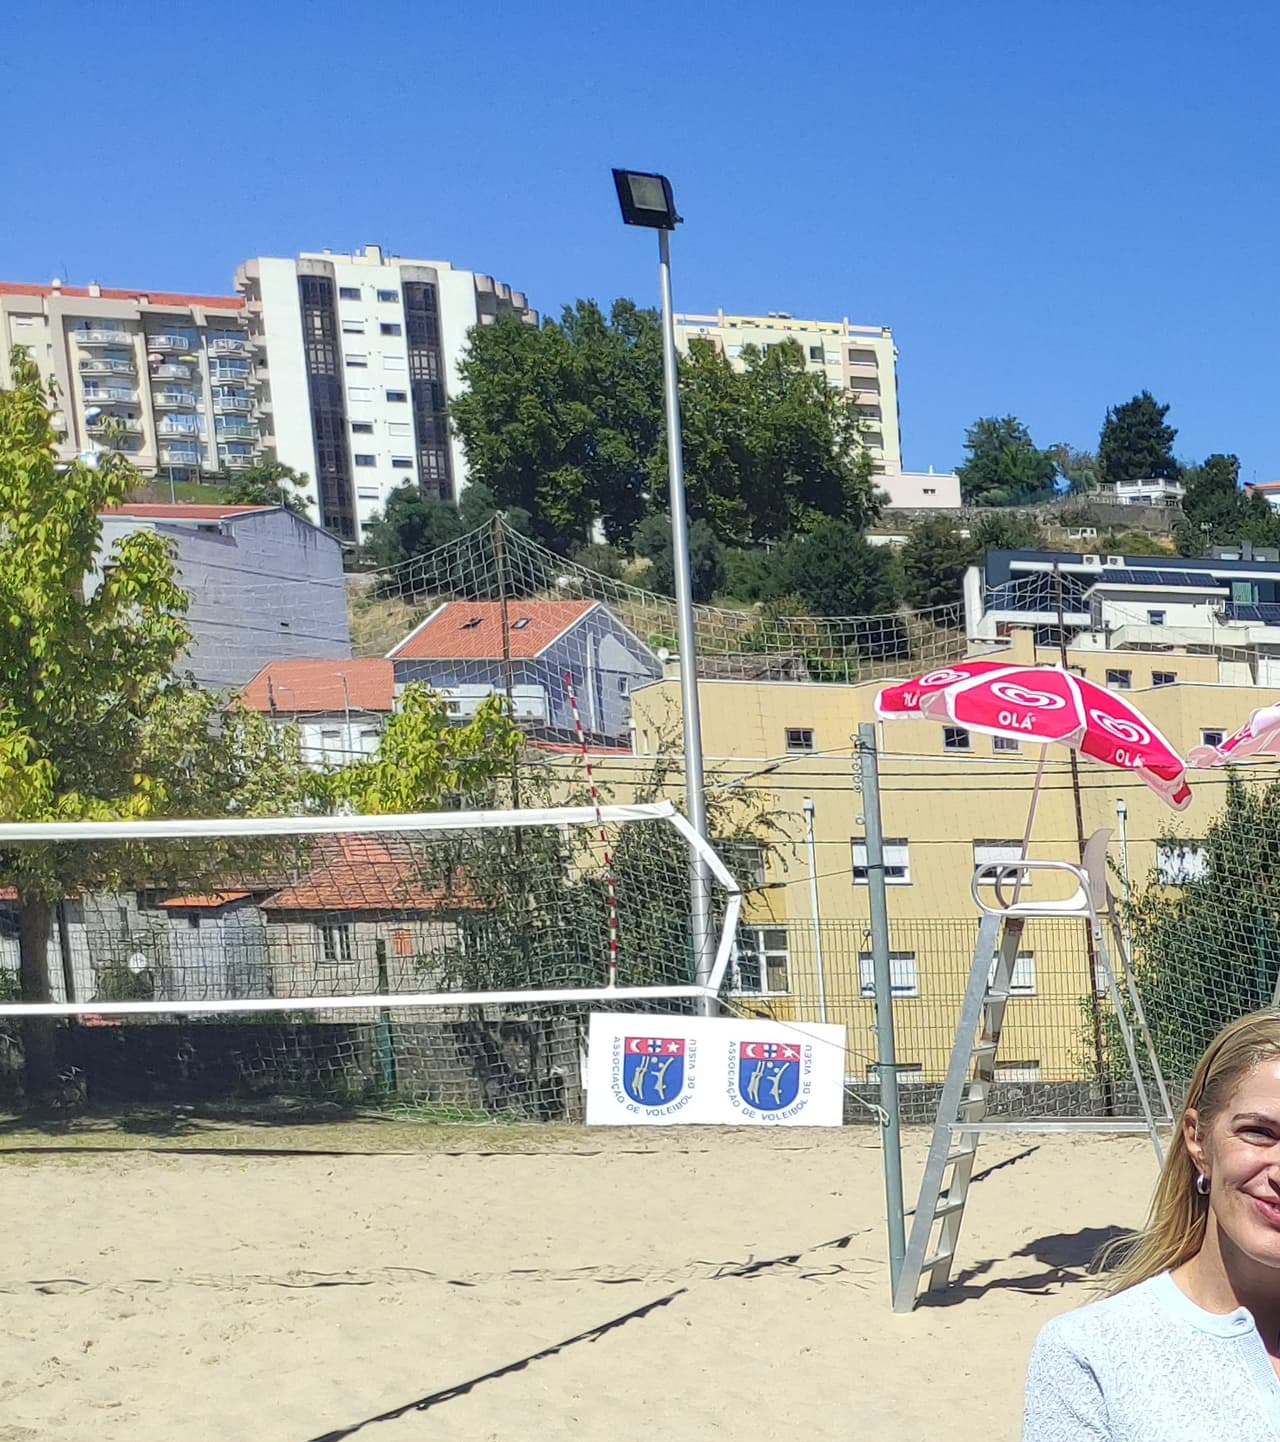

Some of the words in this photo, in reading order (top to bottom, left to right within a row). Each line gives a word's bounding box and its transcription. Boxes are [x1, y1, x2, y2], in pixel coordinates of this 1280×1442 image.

[998, 711, 1034, 730] OLÁ
[1115, 748, 1144, 768] OLÁ
[626, 1103, 641, 1114] DE
[645, 1094, 693, 1117] VOLEIBOL
[687, 1074, 696, 1089] DE
[741, 1107, 756, 1119] DE
[761, 1099, 808, 1121] VOLEIBOL
[803, 1081, 811, 1094] DE
